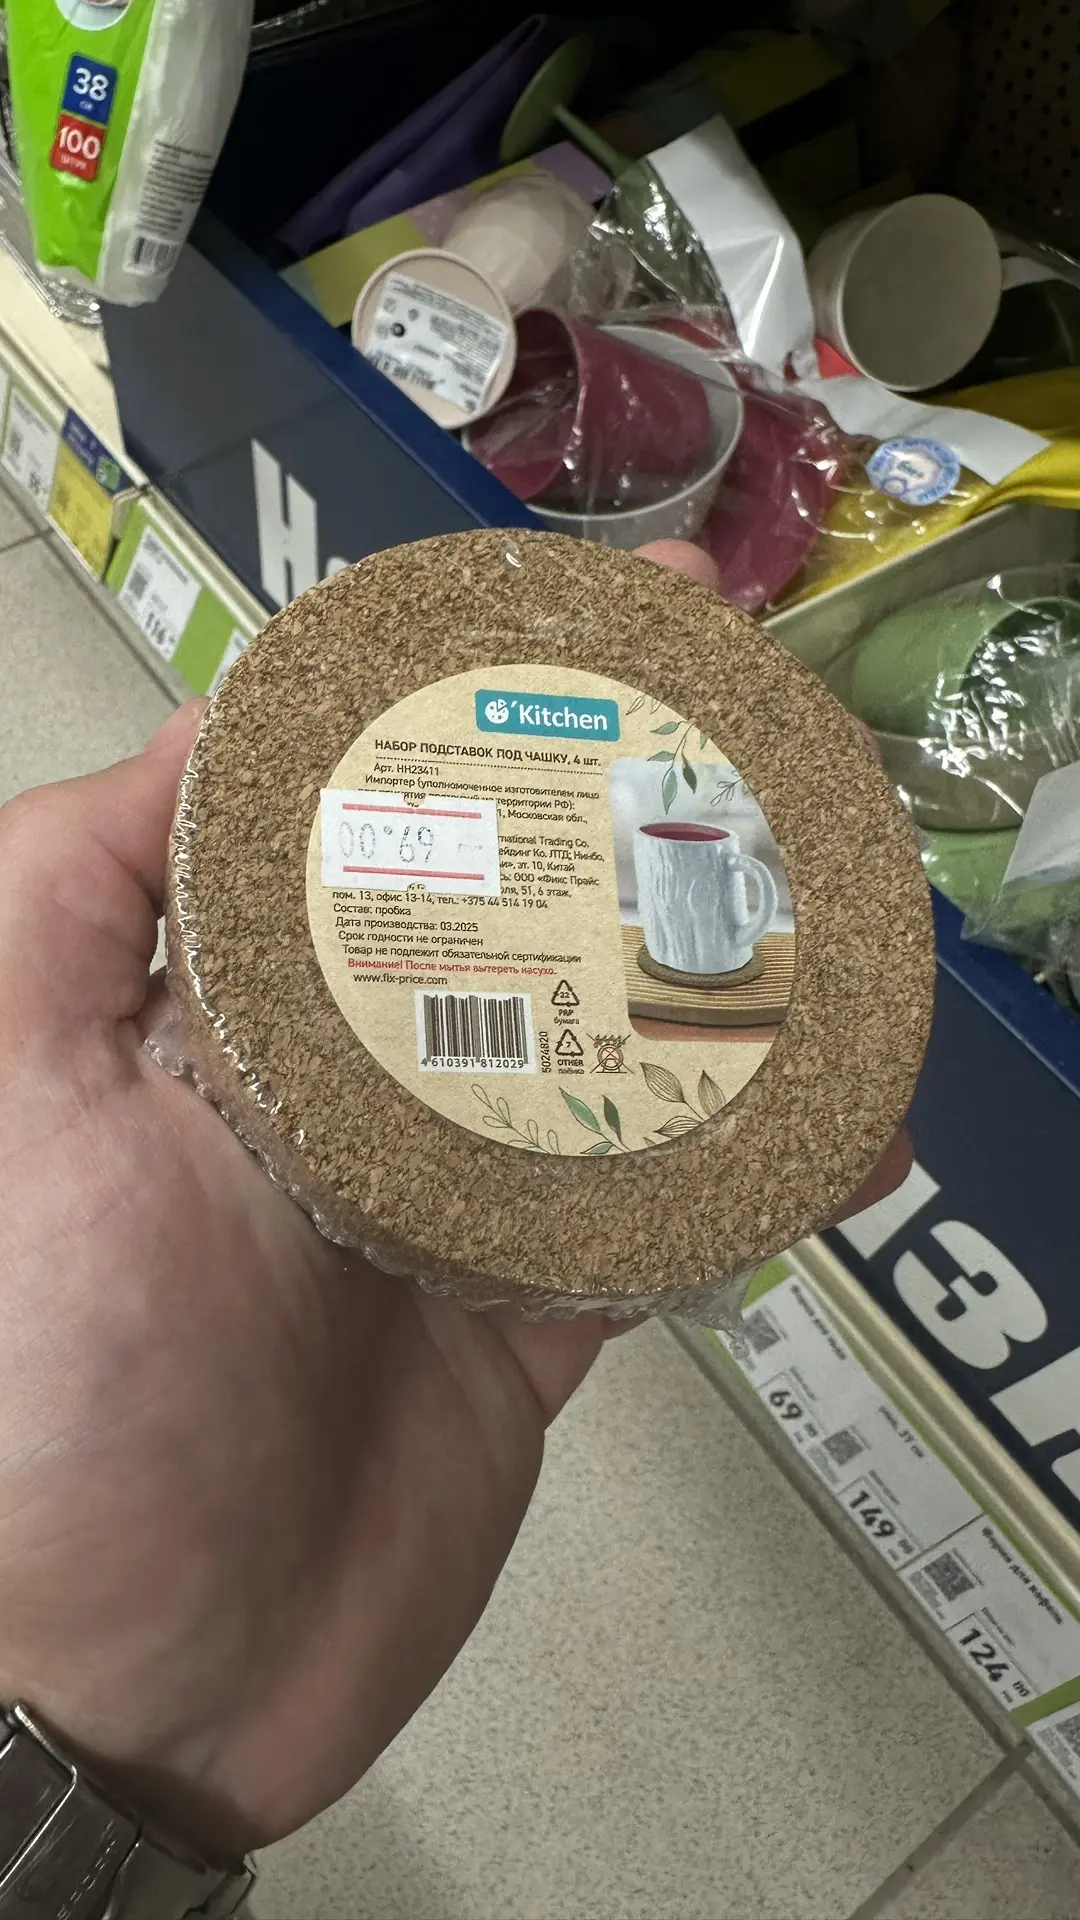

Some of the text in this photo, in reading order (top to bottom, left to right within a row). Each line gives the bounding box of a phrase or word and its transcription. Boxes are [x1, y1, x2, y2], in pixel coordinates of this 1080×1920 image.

[73, 68, 109, 101] 38
[59, 126, 100, 160] 100
[375, 739, 602, 767] НАБОР ПОДСТАВОК ПОД ЧАШКУ, 4 шт.
[374, 763, 395, 773] Арт.
[365, 774, 415, 788] Импортер
[418, 777, 502, 793] (уполномоченное
[504, 786, 575, 798] изготовителем
[554, 799, 575, 811] РФ):
[507, 809, 564, 822] Московская
[538, 836, 573, 849] Trading
[531, 860, 546, 872] 10,
[546, 861, 575, 872] Китай
[513, 872, 535, 883] ООО
[570, 875, 600, 887] Прайс
[332, 891, 356, 900] пом.
[359, 890, 374, 902] 13,
[376, 892, 402, 904] офис
[405, 892, 435, 905] 13-14,
[461, 896, 485, 906] +375
[488, 896, 500, 906] 44
[502, 897, 520, 907] 514
[523, 898, 533, 908] 19
[535, 899, 548, 909] 04
[521, 885, 536, 897] 51,
[537, 886, 545, 896] 6
[546, 888, 572, 899] этаж,
[333, 903, 411, 917] Состав: пробка
[335, 916, 479, 932] Дата производства: 03.2025
[338, 930, 484, 947] Срок годности не ограничен
[342, 943, 582, 965] Товар не подлежит обязательной сертификации
[348, 958, 558, 977] Внимание! После мытья вытереть насухо.
[353, 971, 448, 986] www.fix-price.com
[538, 1031, 552, 1074] 5024820
[557, 1058, 584, 1067] OTHER
[770, 1391, 803, 1420] 69
[849, 1490, 896, 1537] 149
[959, 1628, 1009, 1683] 124
